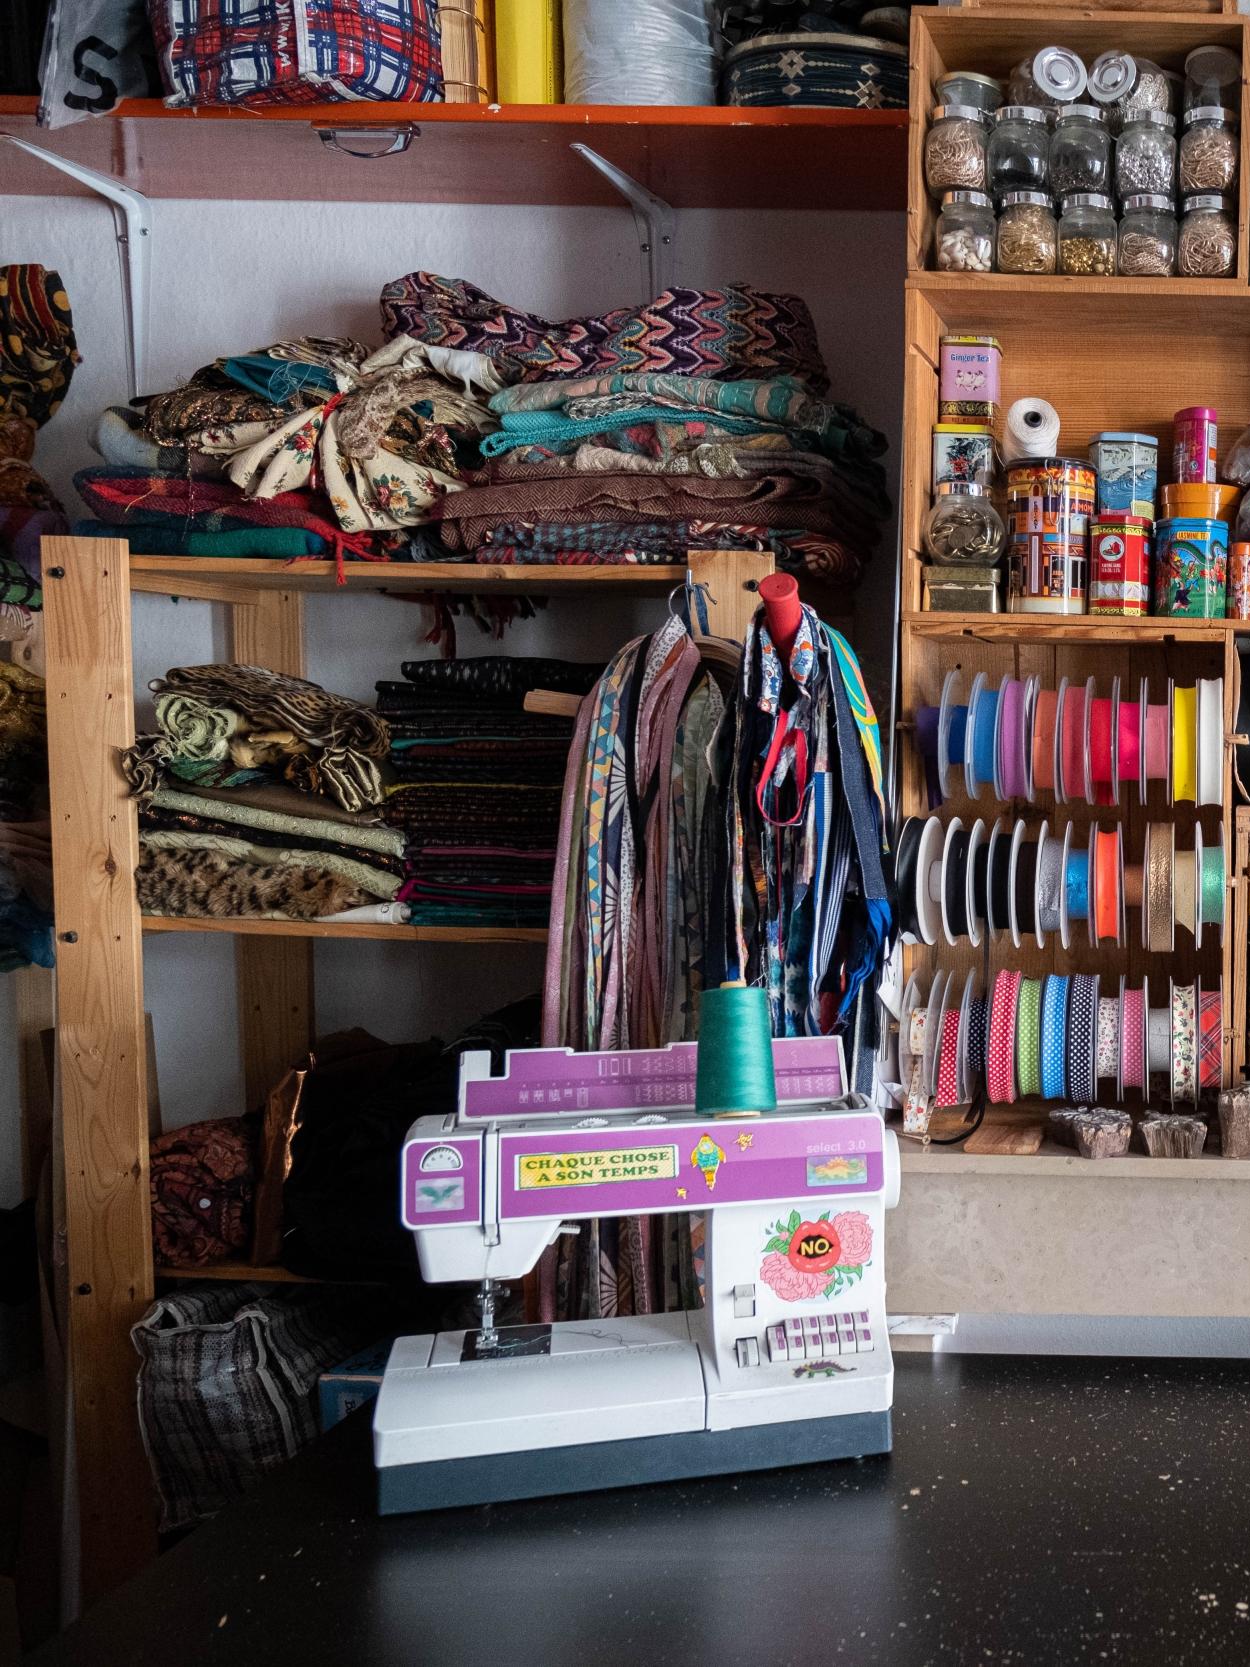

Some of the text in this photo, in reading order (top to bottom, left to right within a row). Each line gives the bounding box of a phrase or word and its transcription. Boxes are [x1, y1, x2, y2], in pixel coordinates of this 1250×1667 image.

[950, 353, 976, 363] Ginger
[806, 1140, 866, 1153] select 3.0
[526, 1151, 670, 1170] CHAQUE CHOSE
[537, 1165, 659, 1182] A SON TEMPS
[801, 1238, 832, 1256] NO.
